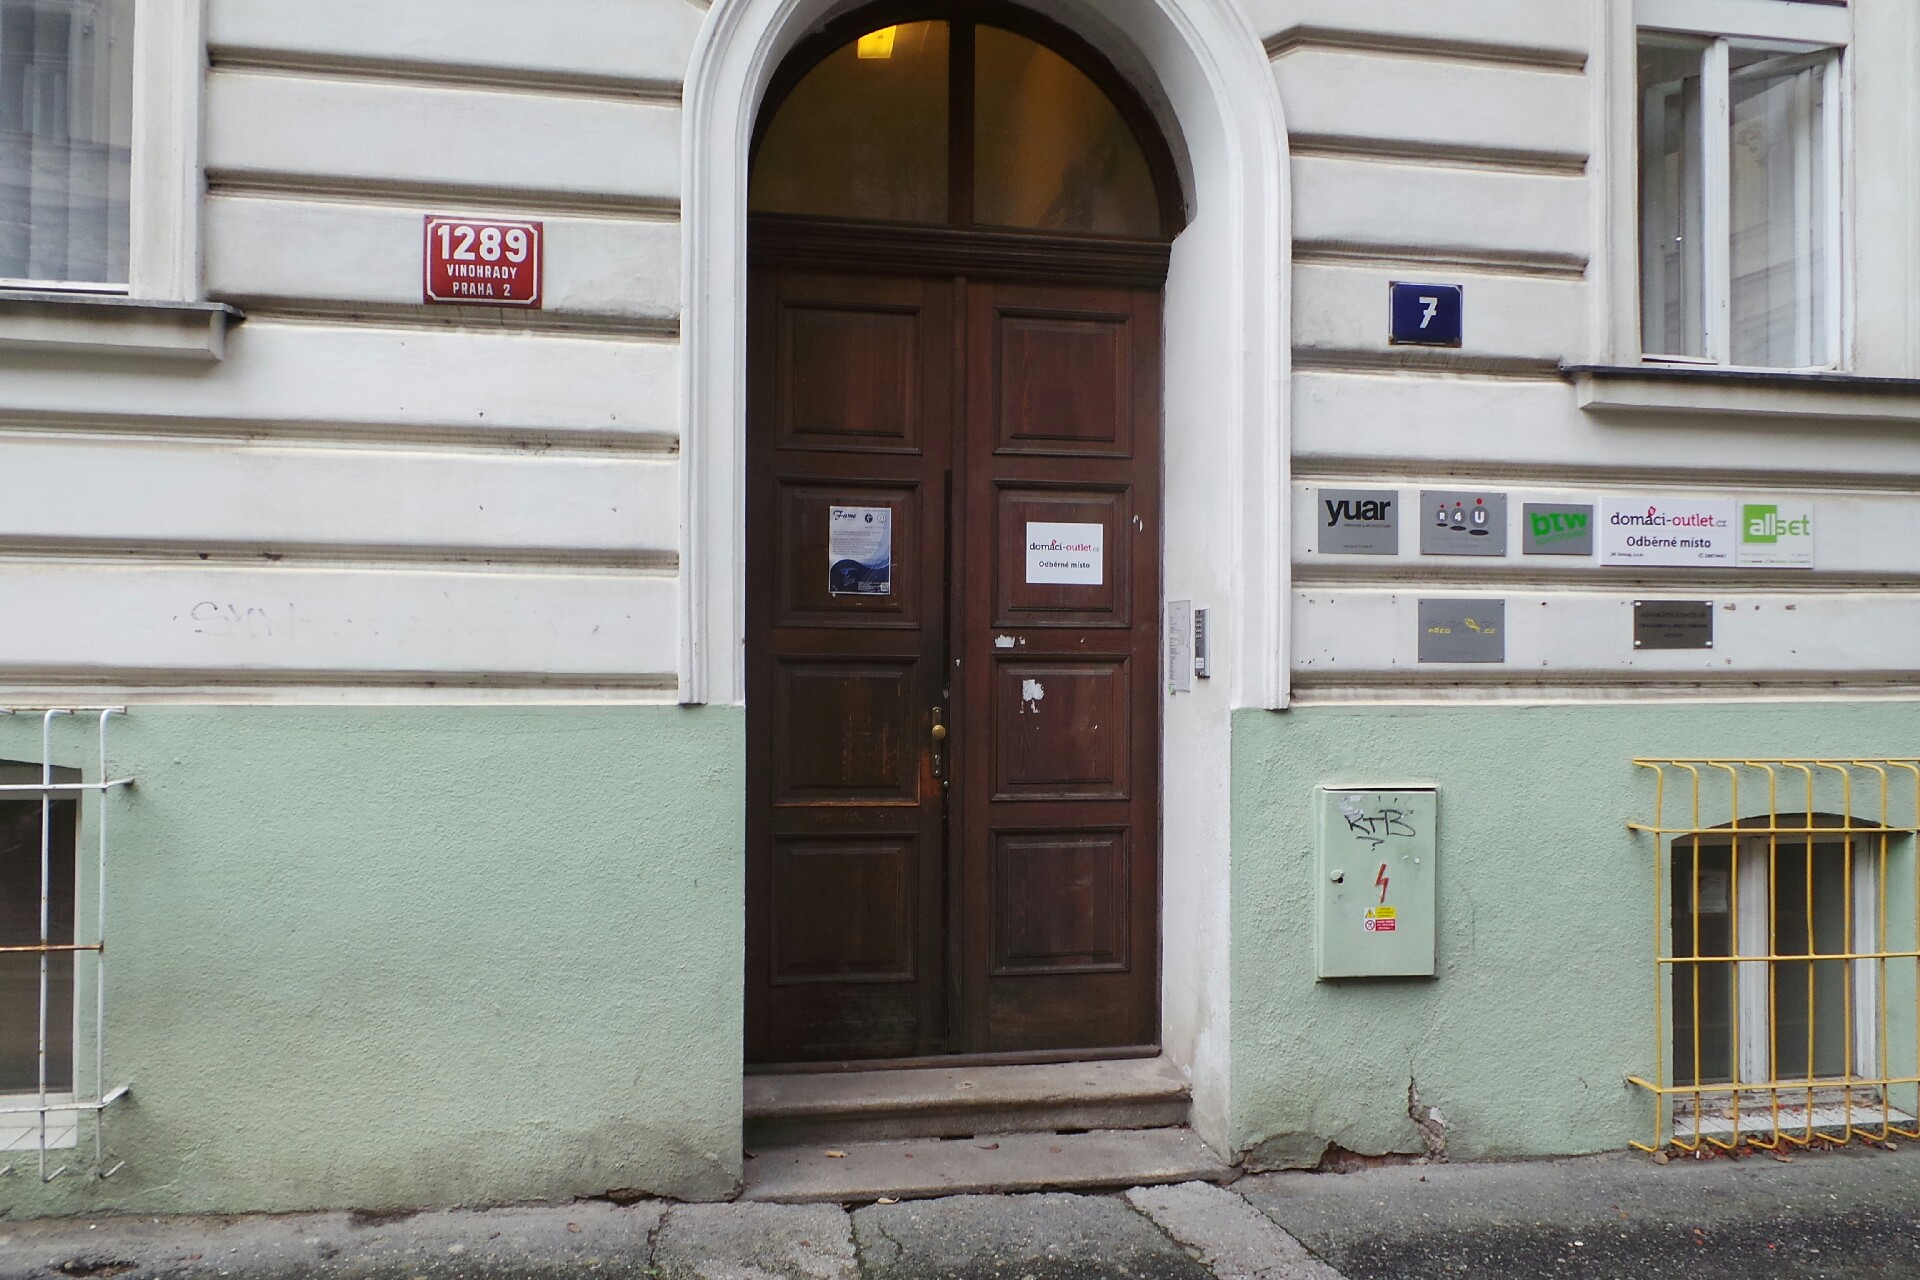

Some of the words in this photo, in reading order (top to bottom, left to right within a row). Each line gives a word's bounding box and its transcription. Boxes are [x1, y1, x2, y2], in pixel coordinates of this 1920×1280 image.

[437, 225, 527, 263] 1289
[446, 264, 517, 279] VINOHRADY
[452, 282, 493, 295] PRAHA
[503, 284, 511, 296] 2
[1419, 296, 1438, 329] 7
[1325, 499, 1391, 527] yuar
[1530, 512, 1587, 536] btw
[1749, 513, 1810, 536] allset
[1626, 536, 1677, 548] Odběrné
[1680, 537, 1711, 548] místo
